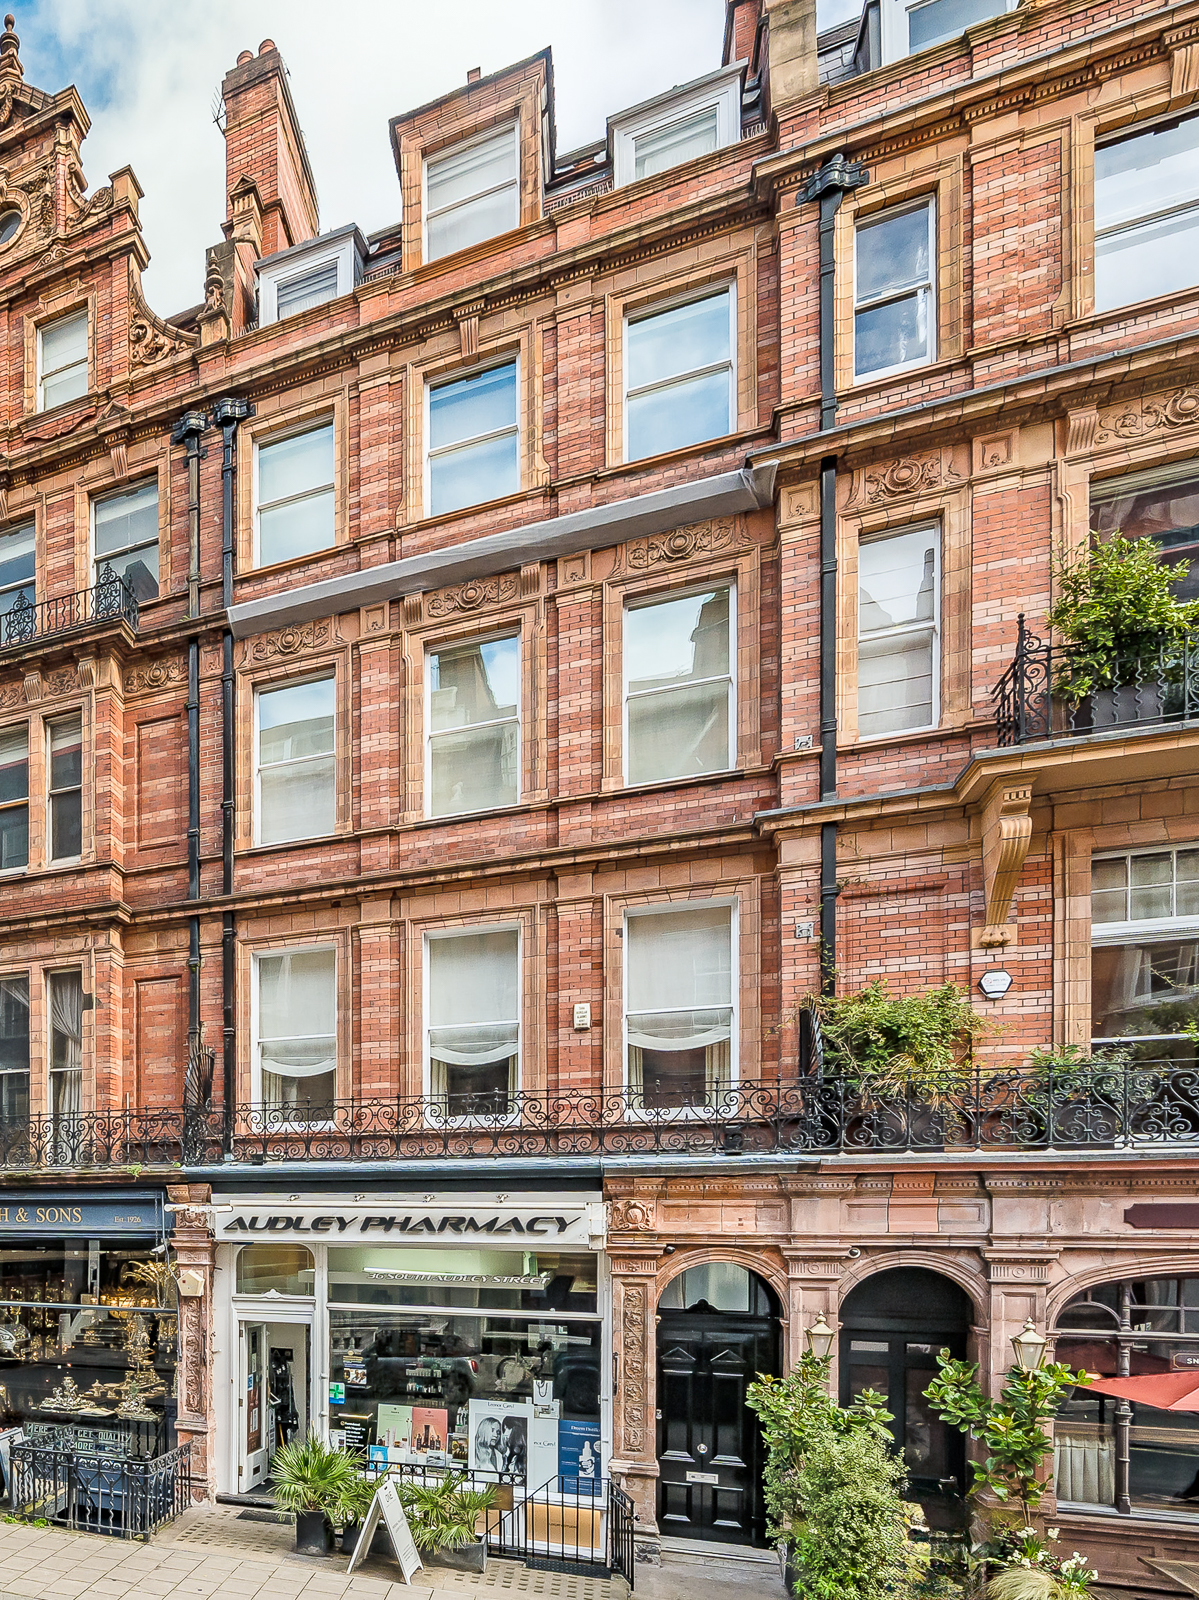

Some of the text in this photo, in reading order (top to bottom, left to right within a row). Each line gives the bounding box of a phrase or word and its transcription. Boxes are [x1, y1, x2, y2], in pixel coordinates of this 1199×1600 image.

[15, 1207, 29, 1223] &
[35, 1207, 82, 1223] SONS
[223, 1216, 581, 1233] AUDLEY PHARMACY
[432, 1274, 491, 1283] AUDLEY
[491, 1275, 550, 1284] STREET
